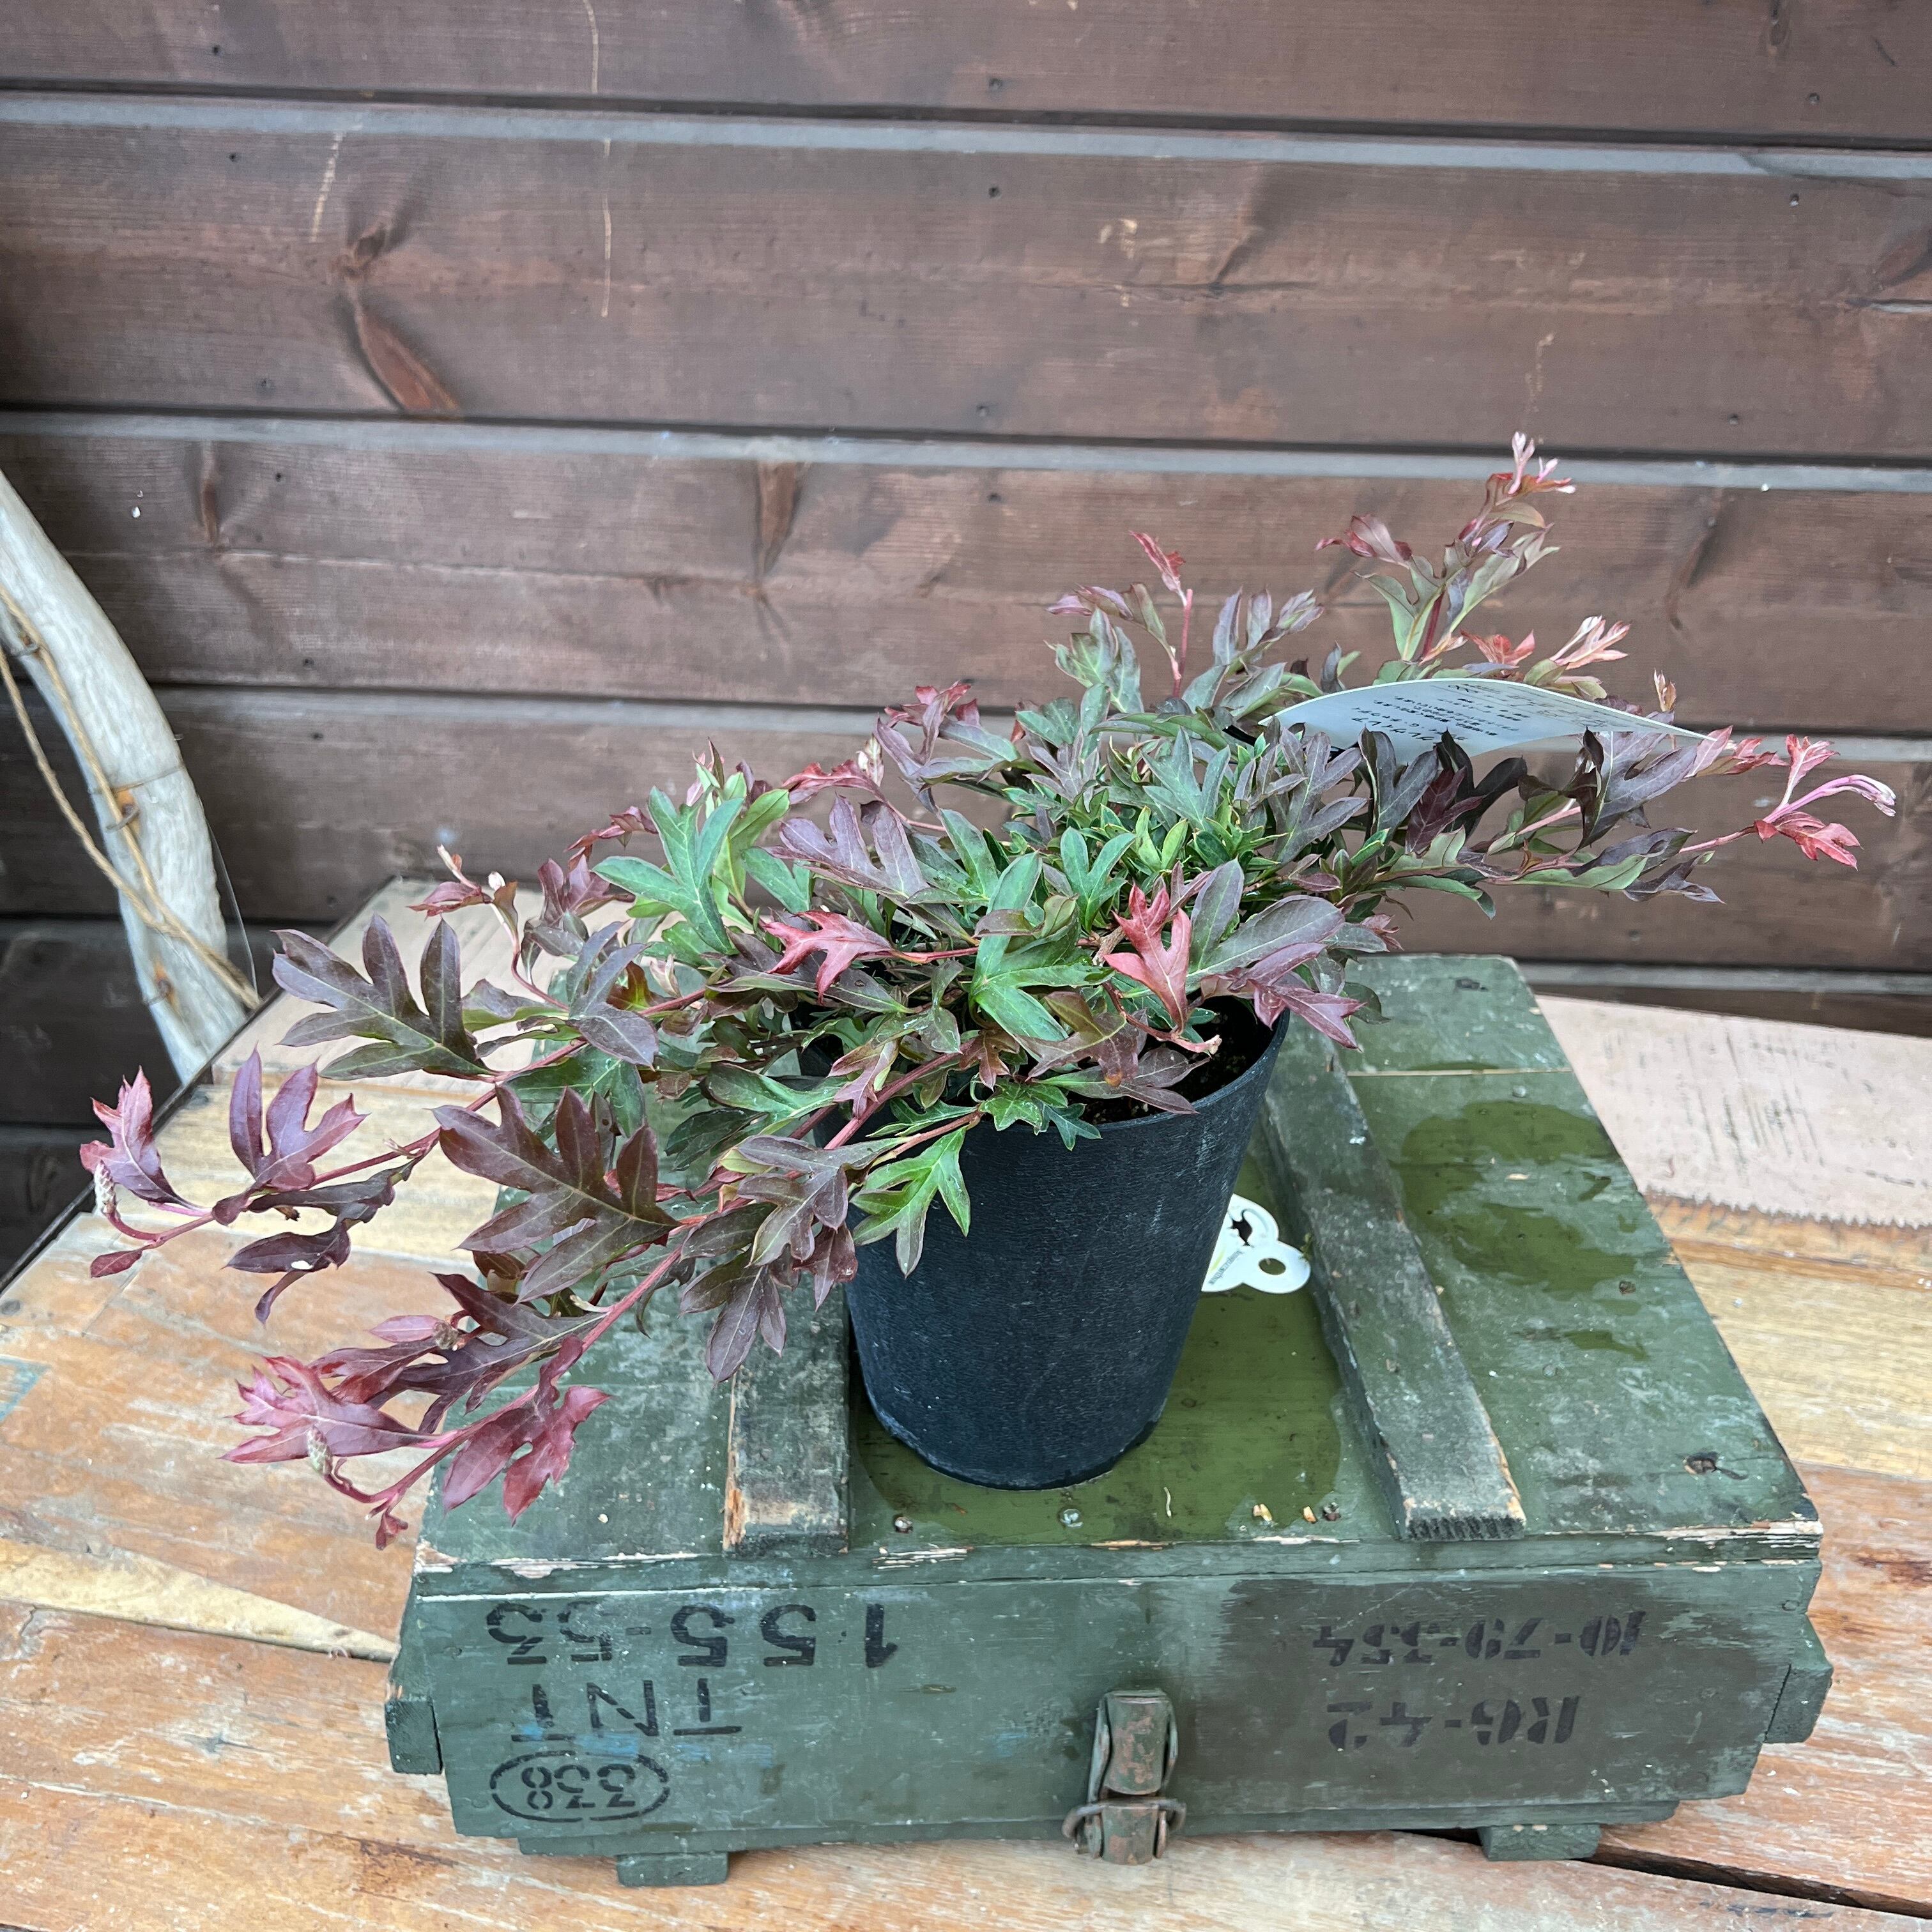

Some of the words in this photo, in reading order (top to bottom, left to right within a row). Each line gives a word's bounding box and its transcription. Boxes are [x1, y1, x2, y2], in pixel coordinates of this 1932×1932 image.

[511, 1678, 742, 1742] TNT
[1326, 1696, 1580, 1750] RG-42
[521, 1764, 636, 1809] 338
